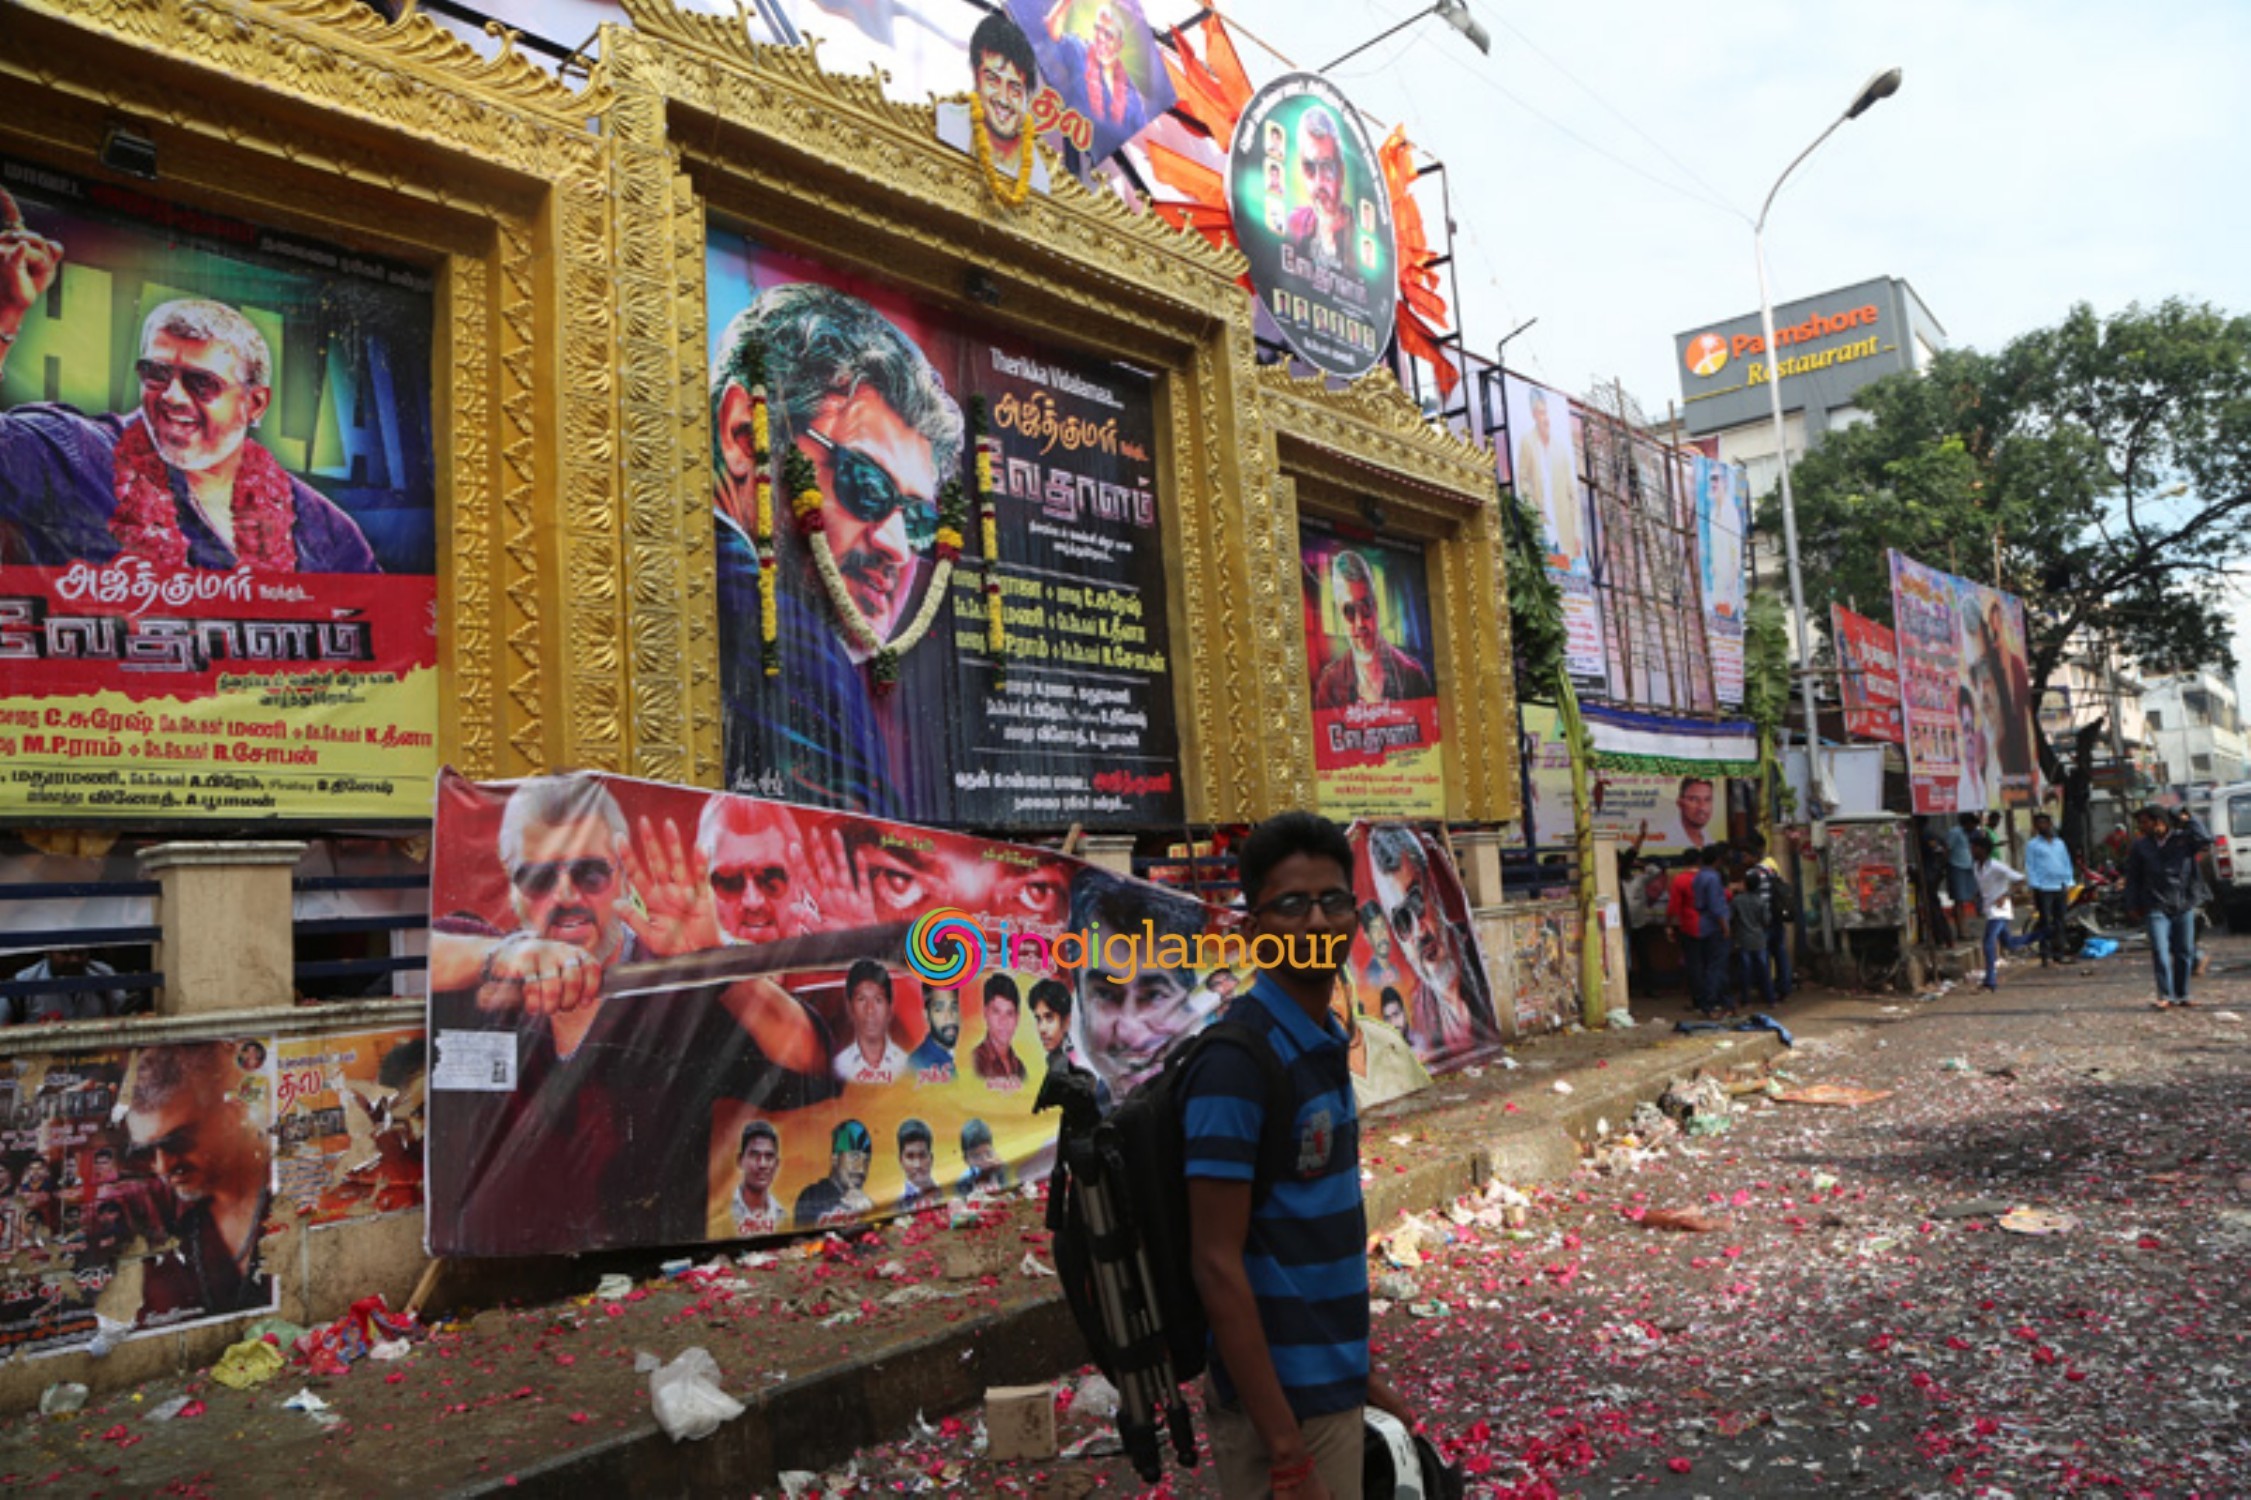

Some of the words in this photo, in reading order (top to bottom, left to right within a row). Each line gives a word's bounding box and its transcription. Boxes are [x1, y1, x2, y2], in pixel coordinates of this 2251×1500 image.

[1031, 87, 1092, 150] தல
[1732, 304, 1878, 358] Pamshore
[55, 555, 253, 616] அஜித்குமார்
[277, 1071, 320, 1115] தல
